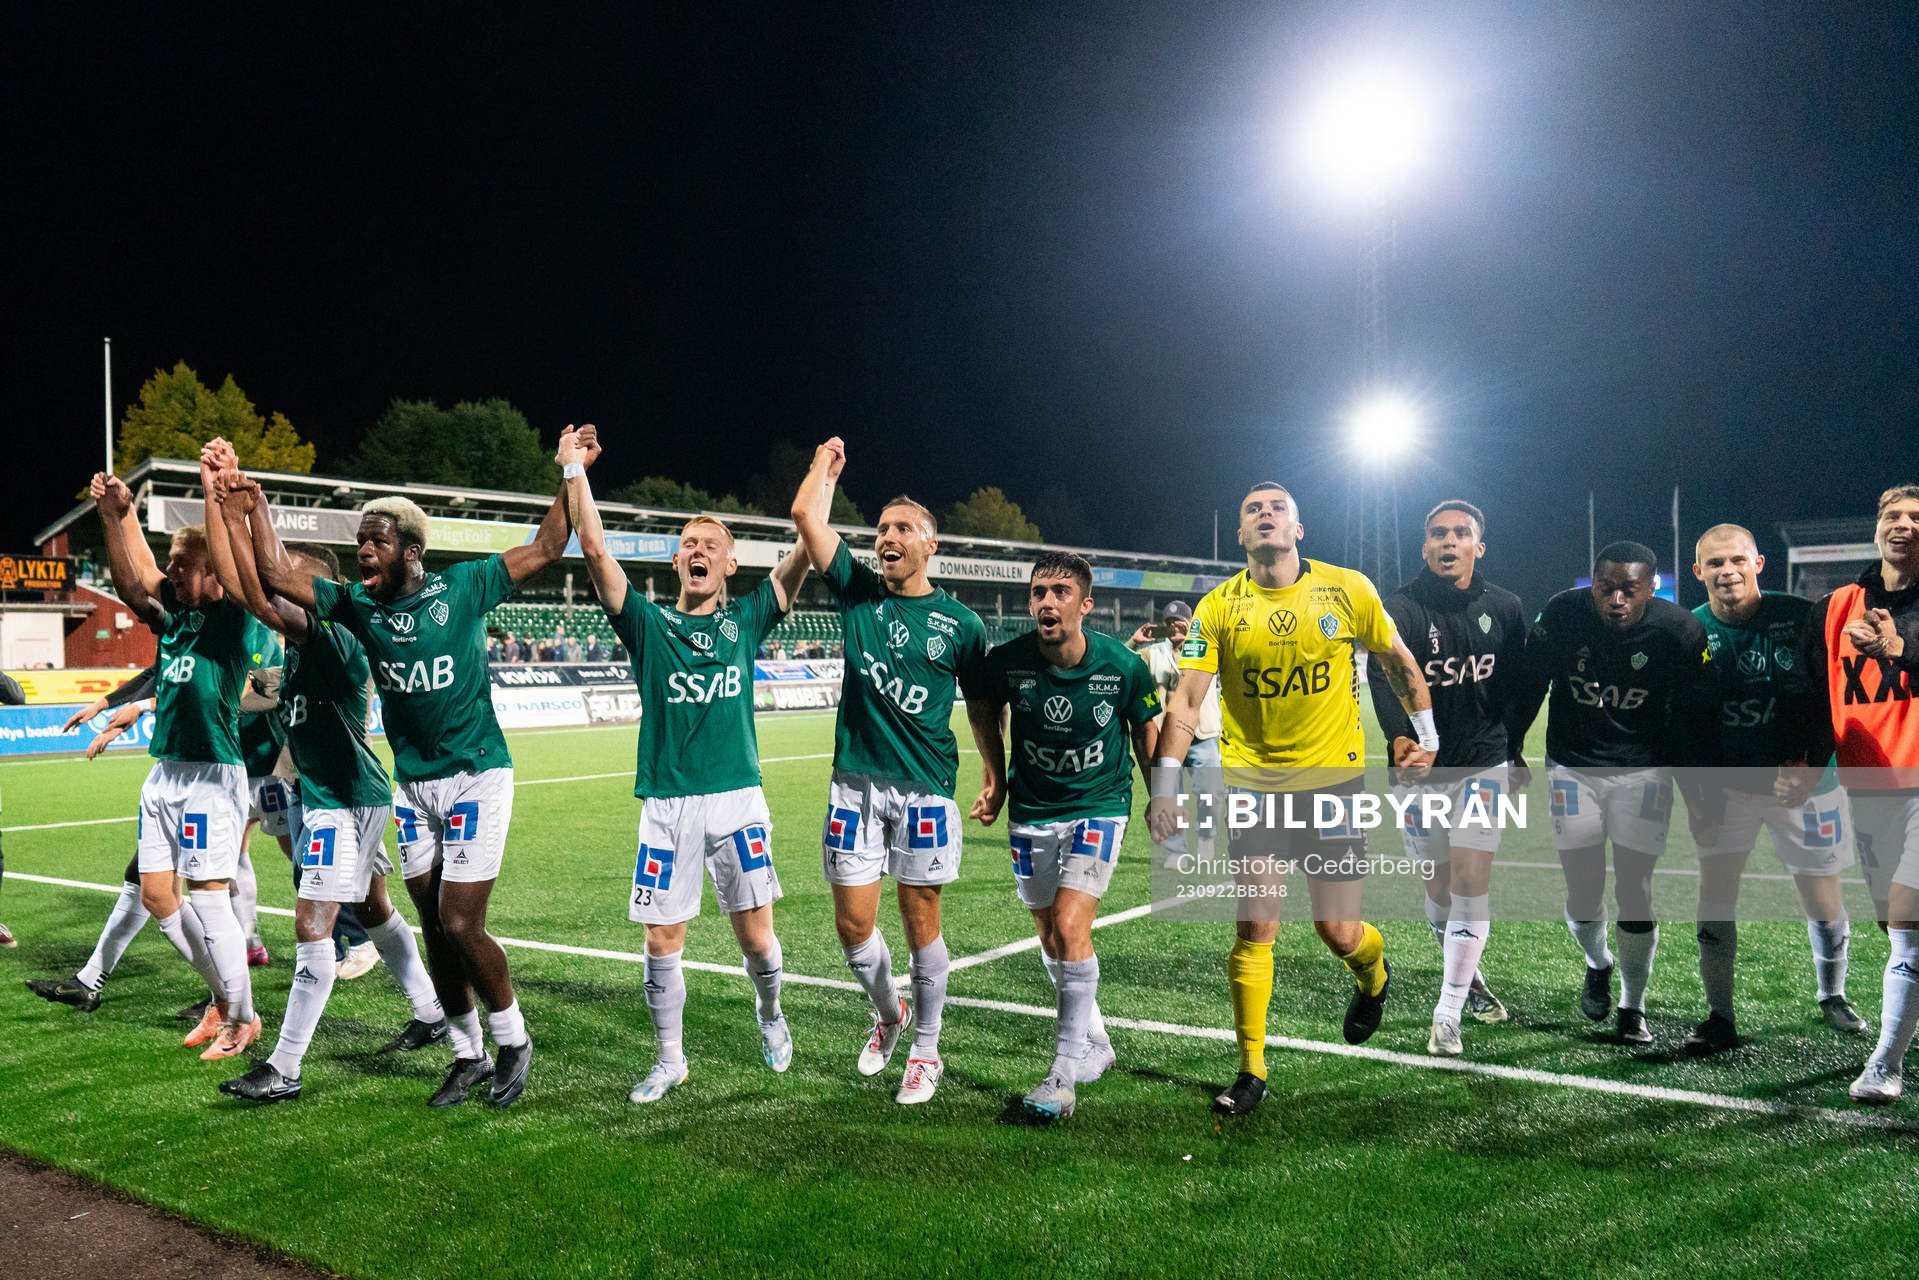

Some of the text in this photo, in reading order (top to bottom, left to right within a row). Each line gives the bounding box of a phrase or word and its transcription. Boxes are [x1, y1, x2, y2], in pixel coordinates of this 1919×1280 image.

[273, 509, 318, 531] ÄNGE
[18, 560, 67, 579] LYKTA
[940, 562, 1022, 579] DOMNARVSVALLEN
[1432, 638, 1440, 654] 3
[379, 655, 455, 693] SSAB
[1243, 661, 1331, 699] SSAB
[1424, 653, 1495, 687] SSAB
[667, 665, 741, 703] SSAB
[1088, 683, 1120, 692] S.K.M.A.
[1023, 739, 1104, 773] SSAB
[635, 887, 652, 906] 23
